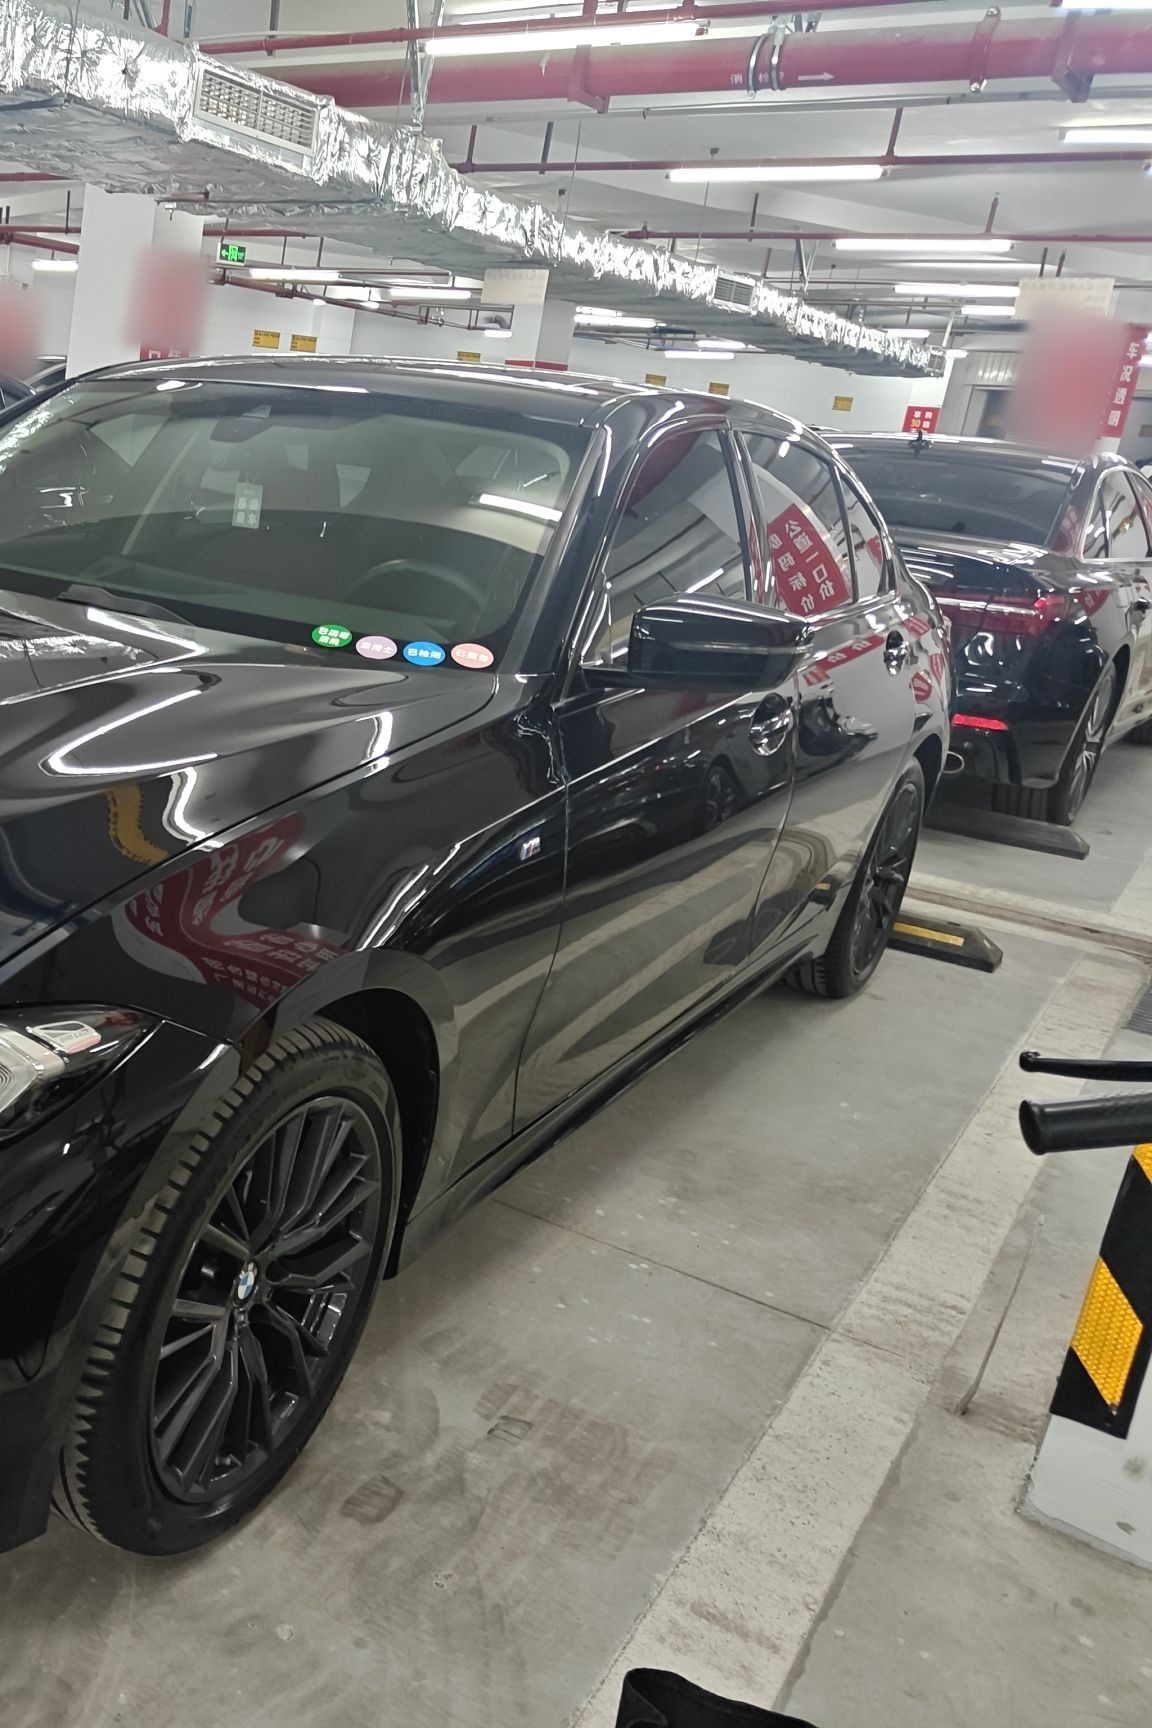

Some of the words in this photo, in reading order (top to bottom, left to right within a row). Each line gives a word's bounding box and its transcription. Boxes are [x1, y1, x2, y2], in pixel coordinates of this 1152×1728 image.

[1107, 342, 1141, 427] 车况透明
[407, 647, 442, 659] 已检测
